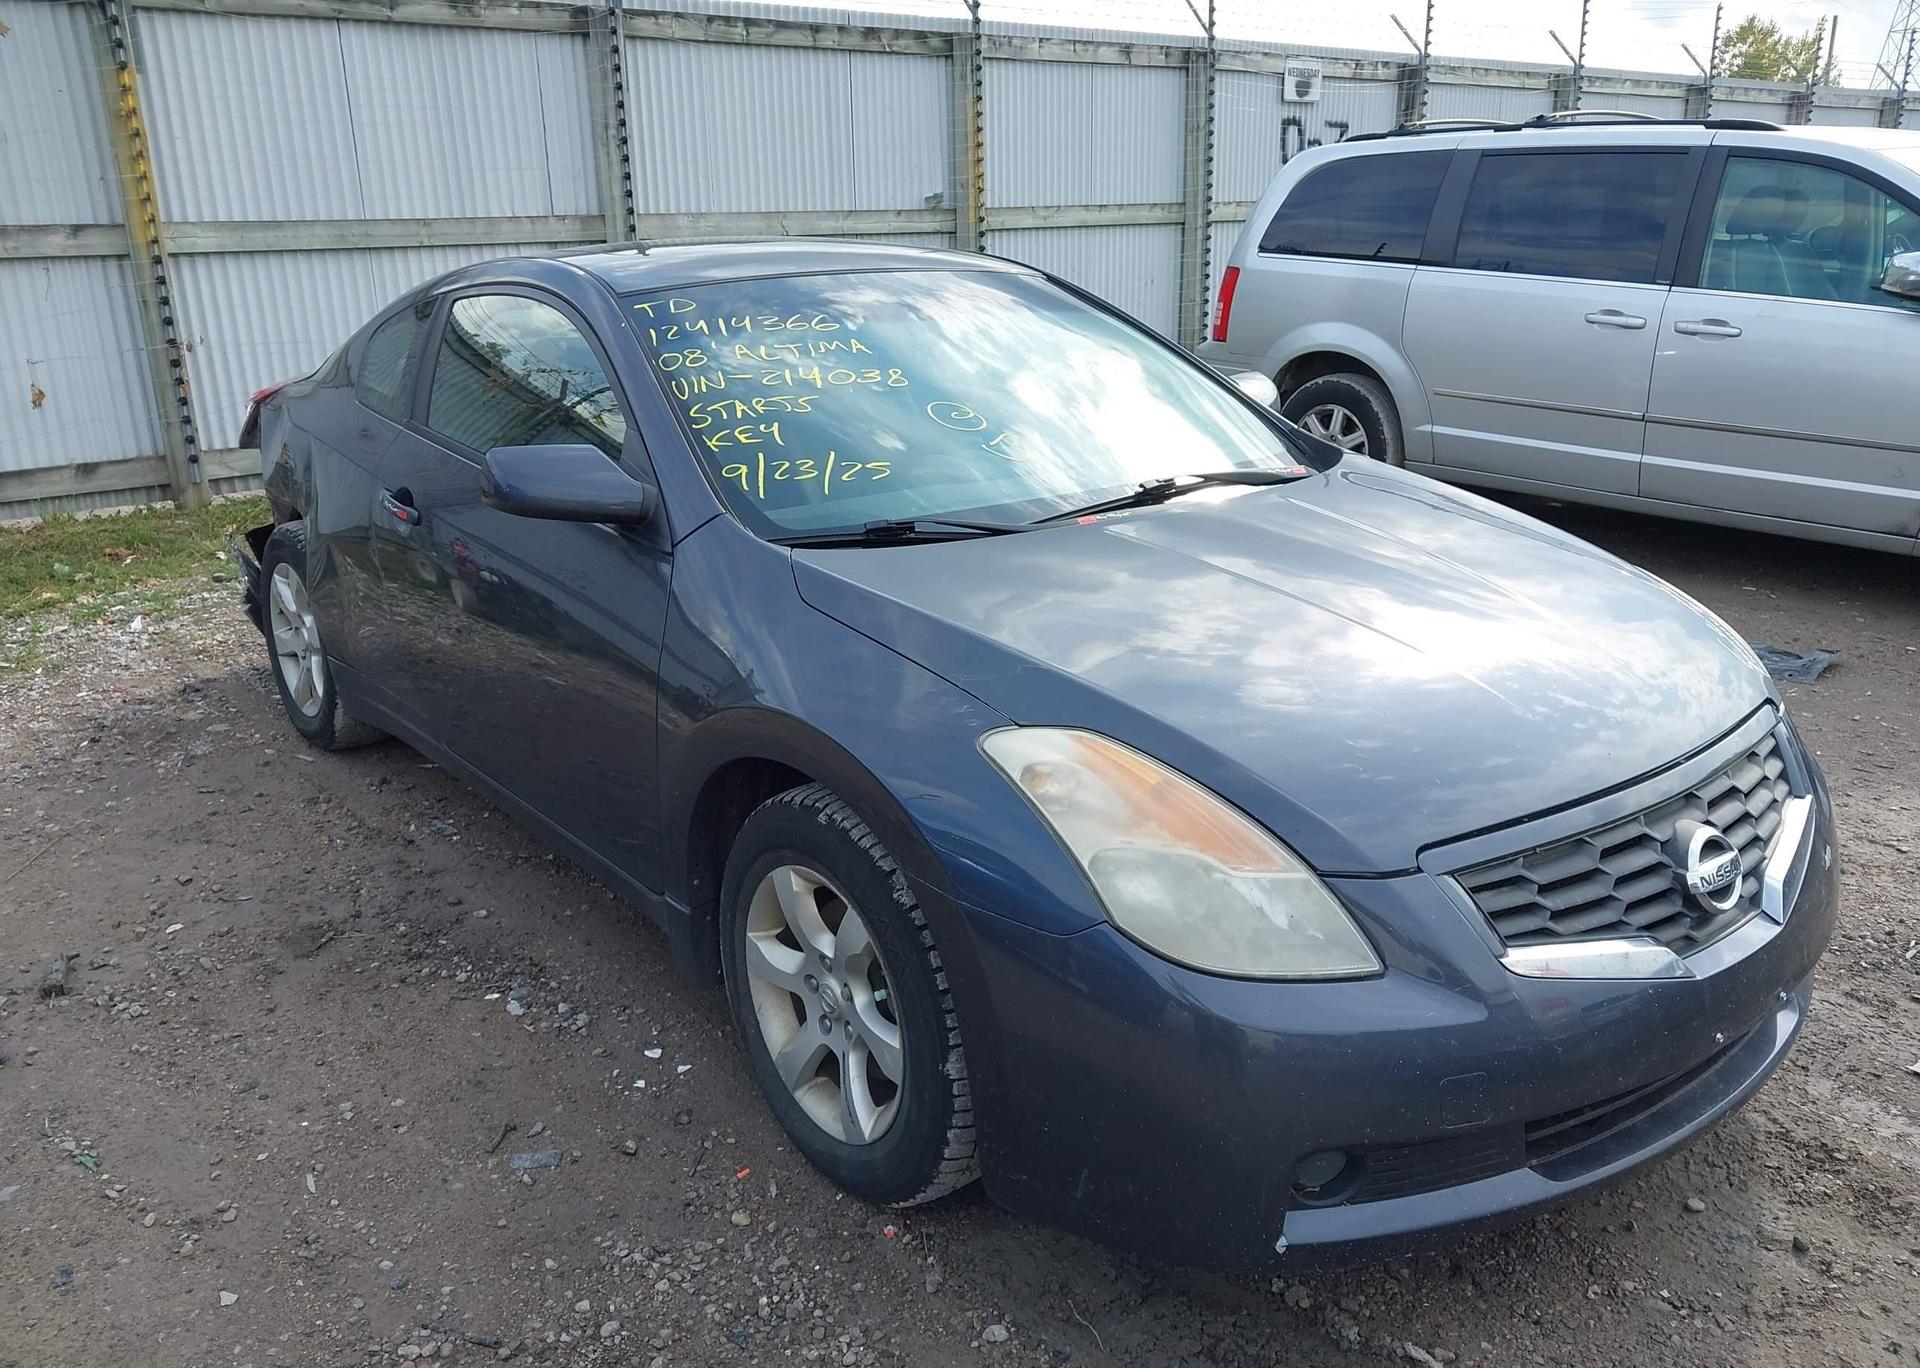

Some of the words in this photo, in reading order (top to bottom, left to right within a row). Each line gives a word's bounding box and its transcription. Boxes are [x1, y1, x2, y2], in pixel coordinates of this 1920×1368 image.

[1287, 67, 1320, 80] WEDNESDAY
[633, 298, 697, 318] TD
[649, 314, 841, 347] 12414366
[734, 337, 873, 361] ALTIMA
[689, 395, 820, 428] STARTS
[702, 421, 786, 452] KEY
[721, 450, 892, 499] 9/23/25
[1700, 862, 1741, 888] NISSAN
